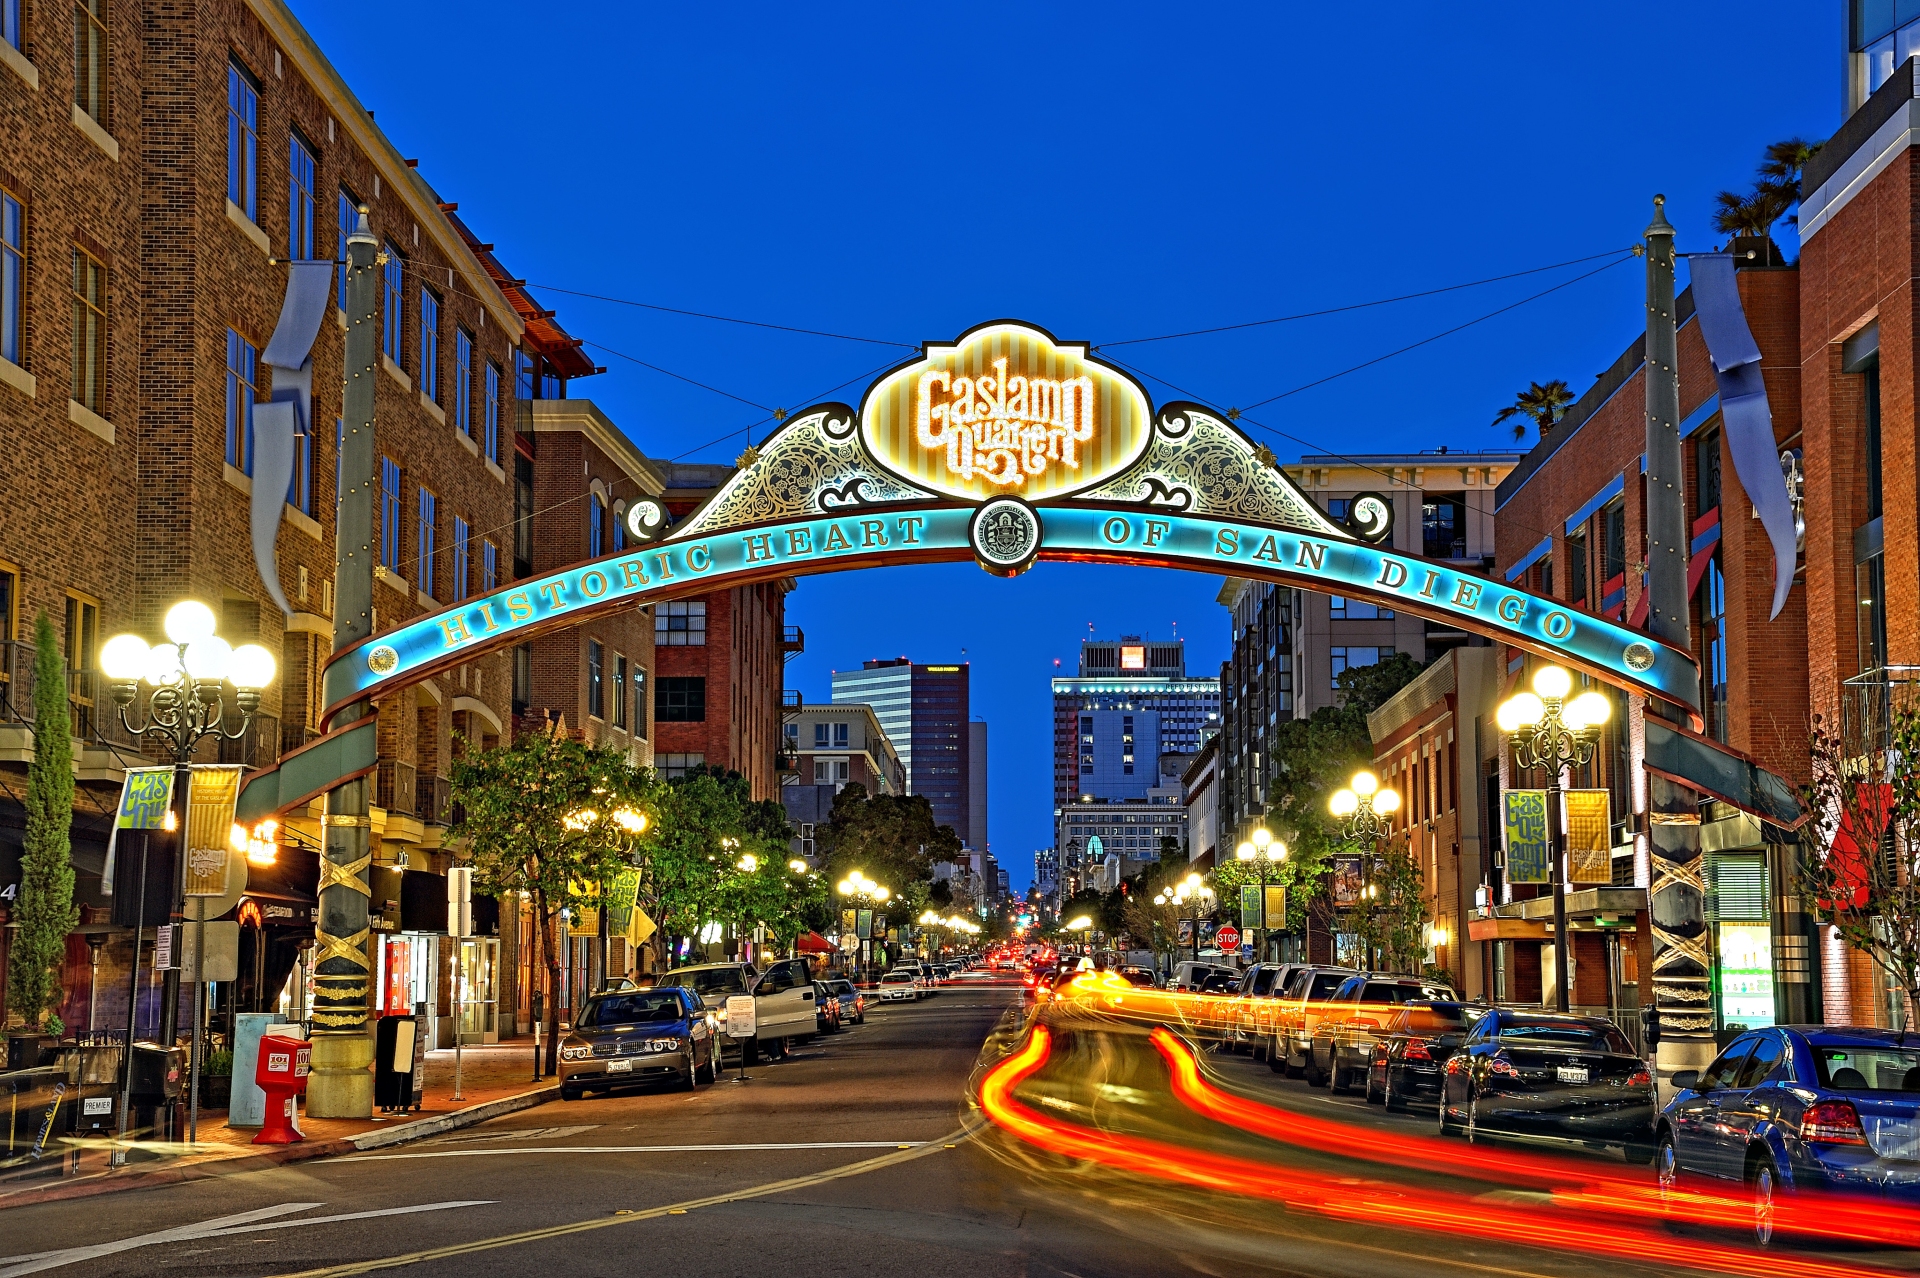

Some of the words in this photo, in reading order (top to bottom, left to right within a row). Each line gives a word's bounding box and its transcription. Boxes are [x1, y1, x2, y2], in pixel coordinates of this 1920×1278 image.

[917, 357, 1094, 468] Gaslamp
[947, 419, 1068, 485] Quarter
[437, 544, 711, 647] HISTORIC
[743, 517, 923, 562] HEART
[1103, 517, 1170, 547] OF
[1215, 528, 1329, 570] SAN
[1376, 558, 1573, 639] DIEGO
[121, 772, 169, 817] Gas
[0, 884, 17, 901] 4
[1218, 933, 1238, 943] STOP
[297, 1052, 309, 1064] 101
[85, 1101, 110, 1109] PREMIER
